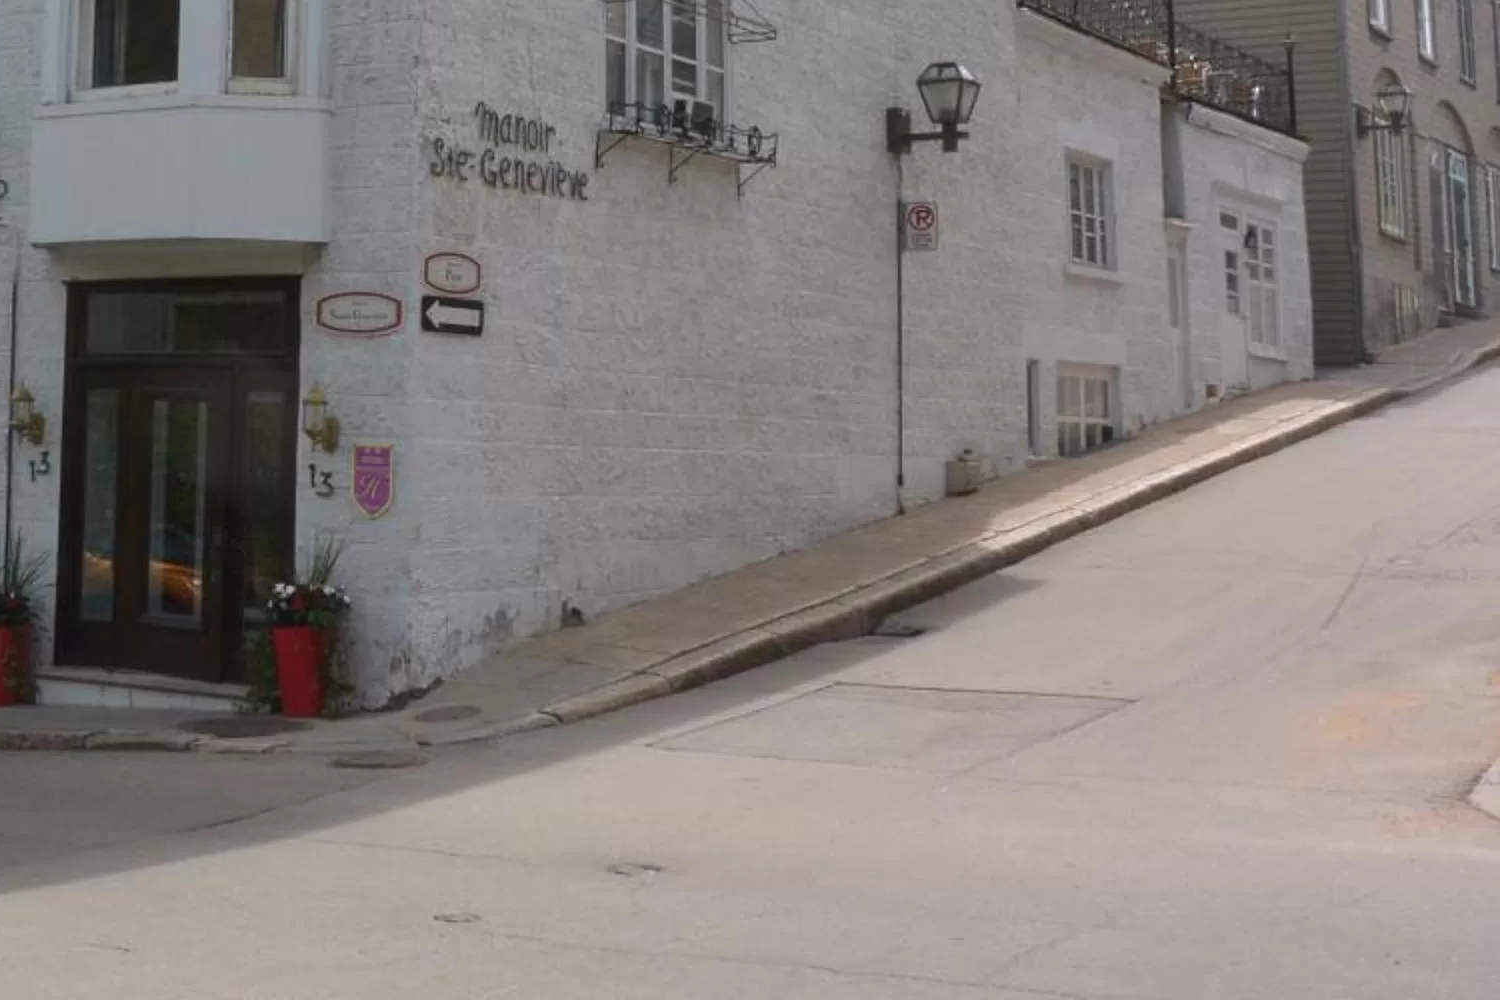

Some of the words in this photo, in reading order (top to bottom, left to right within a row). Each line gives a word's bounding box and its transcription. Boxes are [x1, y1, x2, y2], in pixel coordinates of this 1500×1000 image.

[430, 138, 591, 200] Ste-Geneviève
[29, 450, 52, 481] 13
[307, 463, 335, 498] 13
